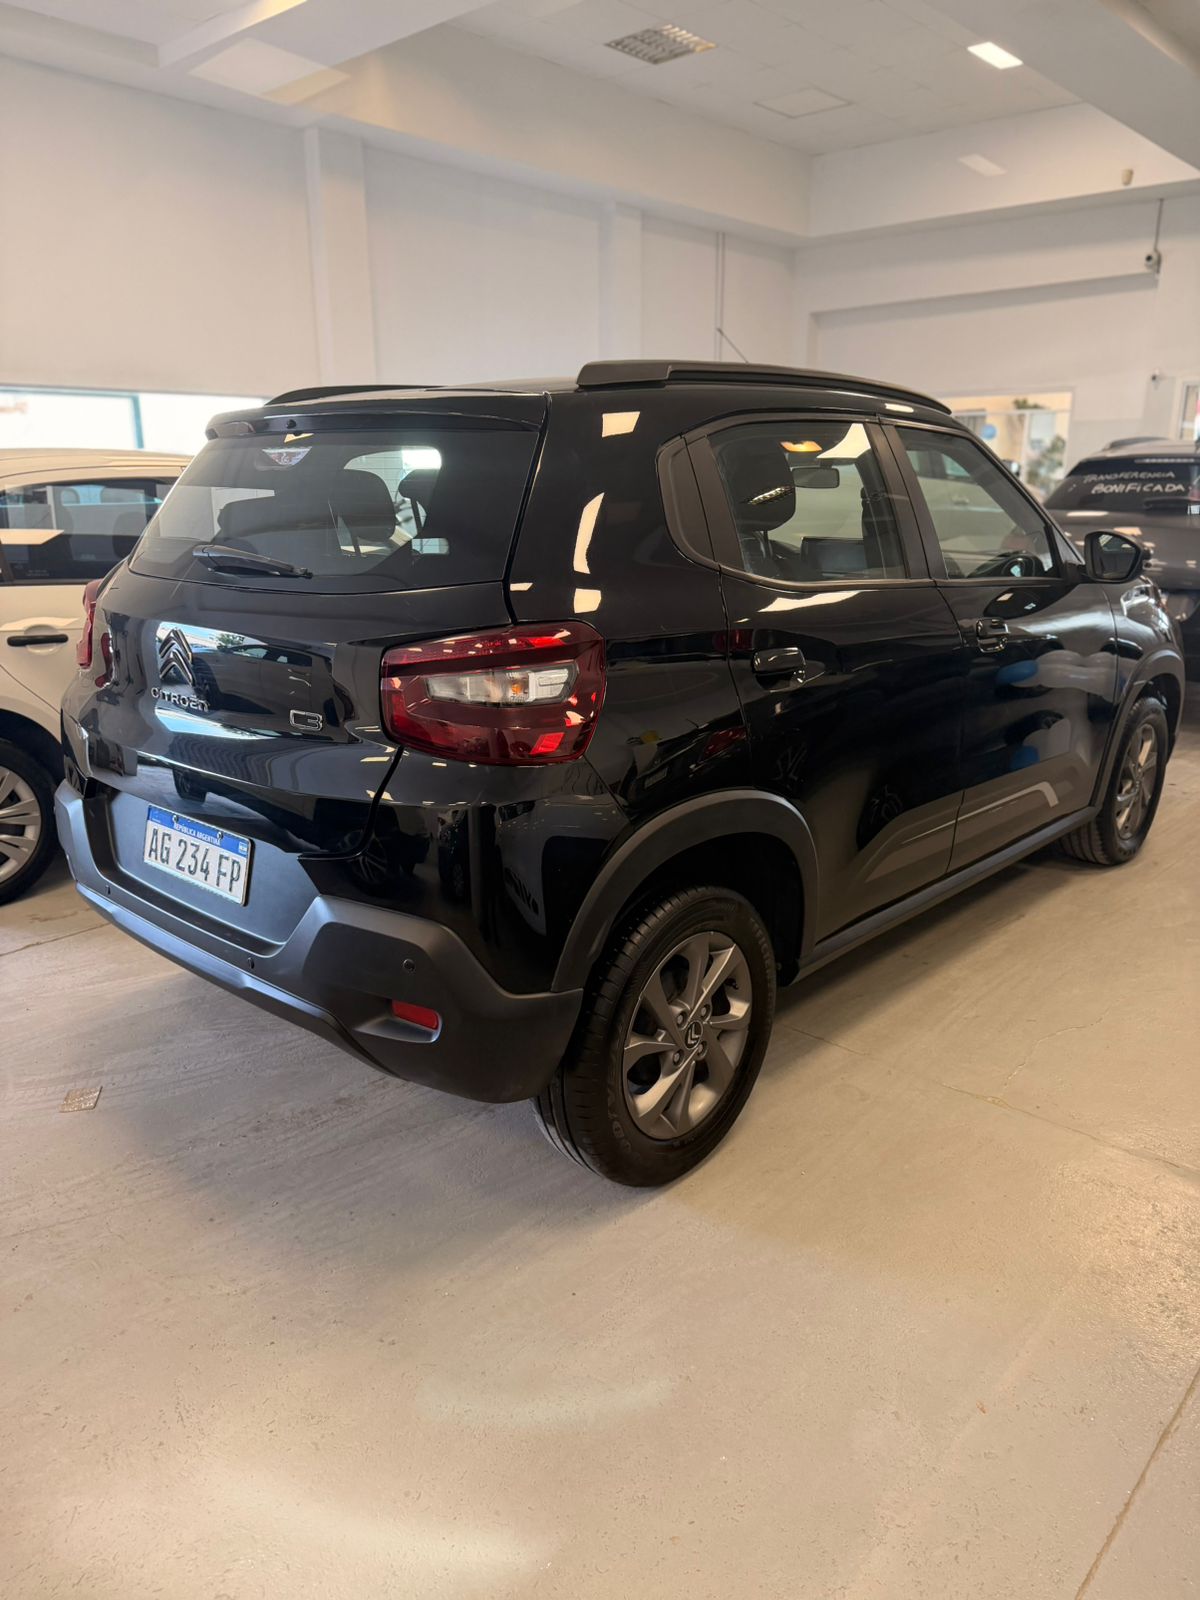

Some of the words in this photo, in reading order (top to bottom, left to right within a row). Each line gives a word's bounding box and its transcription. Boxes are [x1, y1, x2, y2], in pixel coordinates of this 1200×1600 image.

[1091, 482, 1185, 494] BONIFICADA
[289, 709, 323, 731] C3
[148, 827, 172, 865] AG
[175, 838, 210, 882] 234
[215, 853, 241, 893] FP
